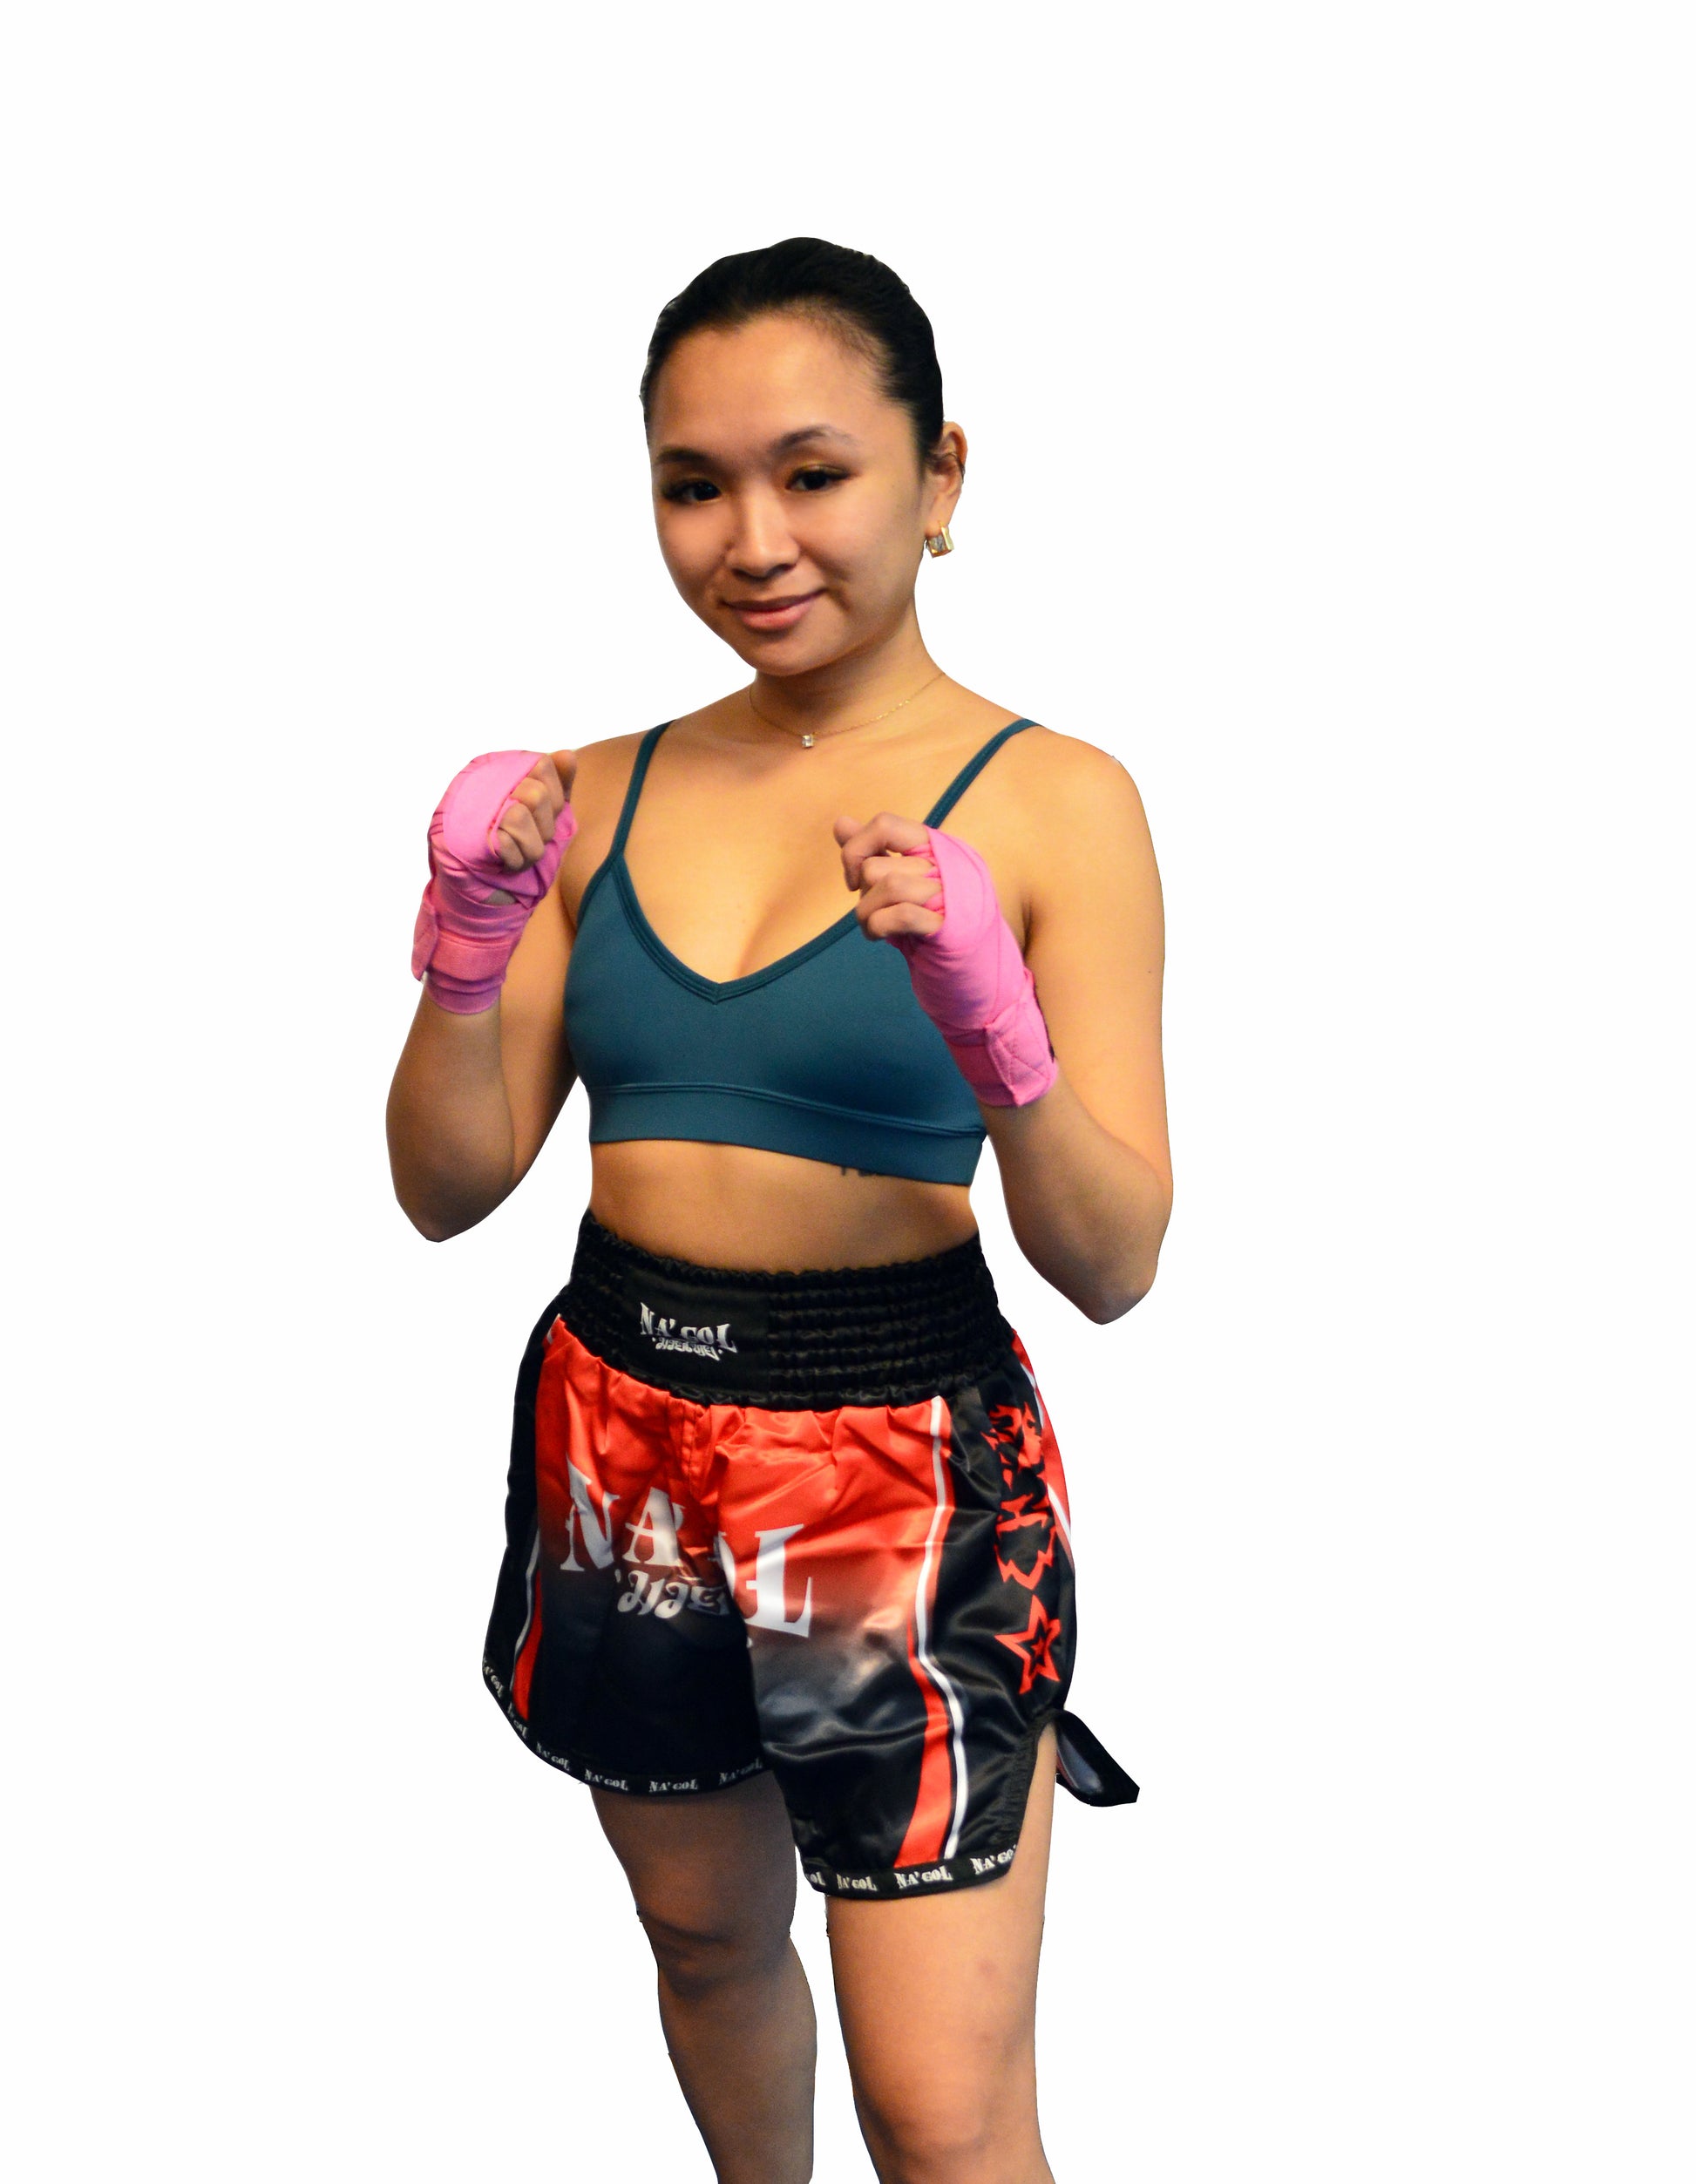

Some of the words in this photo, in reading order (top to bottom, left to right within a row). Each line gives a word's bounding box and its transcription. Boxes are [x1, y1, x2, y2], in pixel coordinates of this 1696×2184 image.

[641, 1302, 737, 1353] NA'GOL
[648, 1779, 698, 1793] NA'GOL
[969, 1844, 1017, 1875] NA'GO
[893, 1865, 953, 1889] NA'GOL
